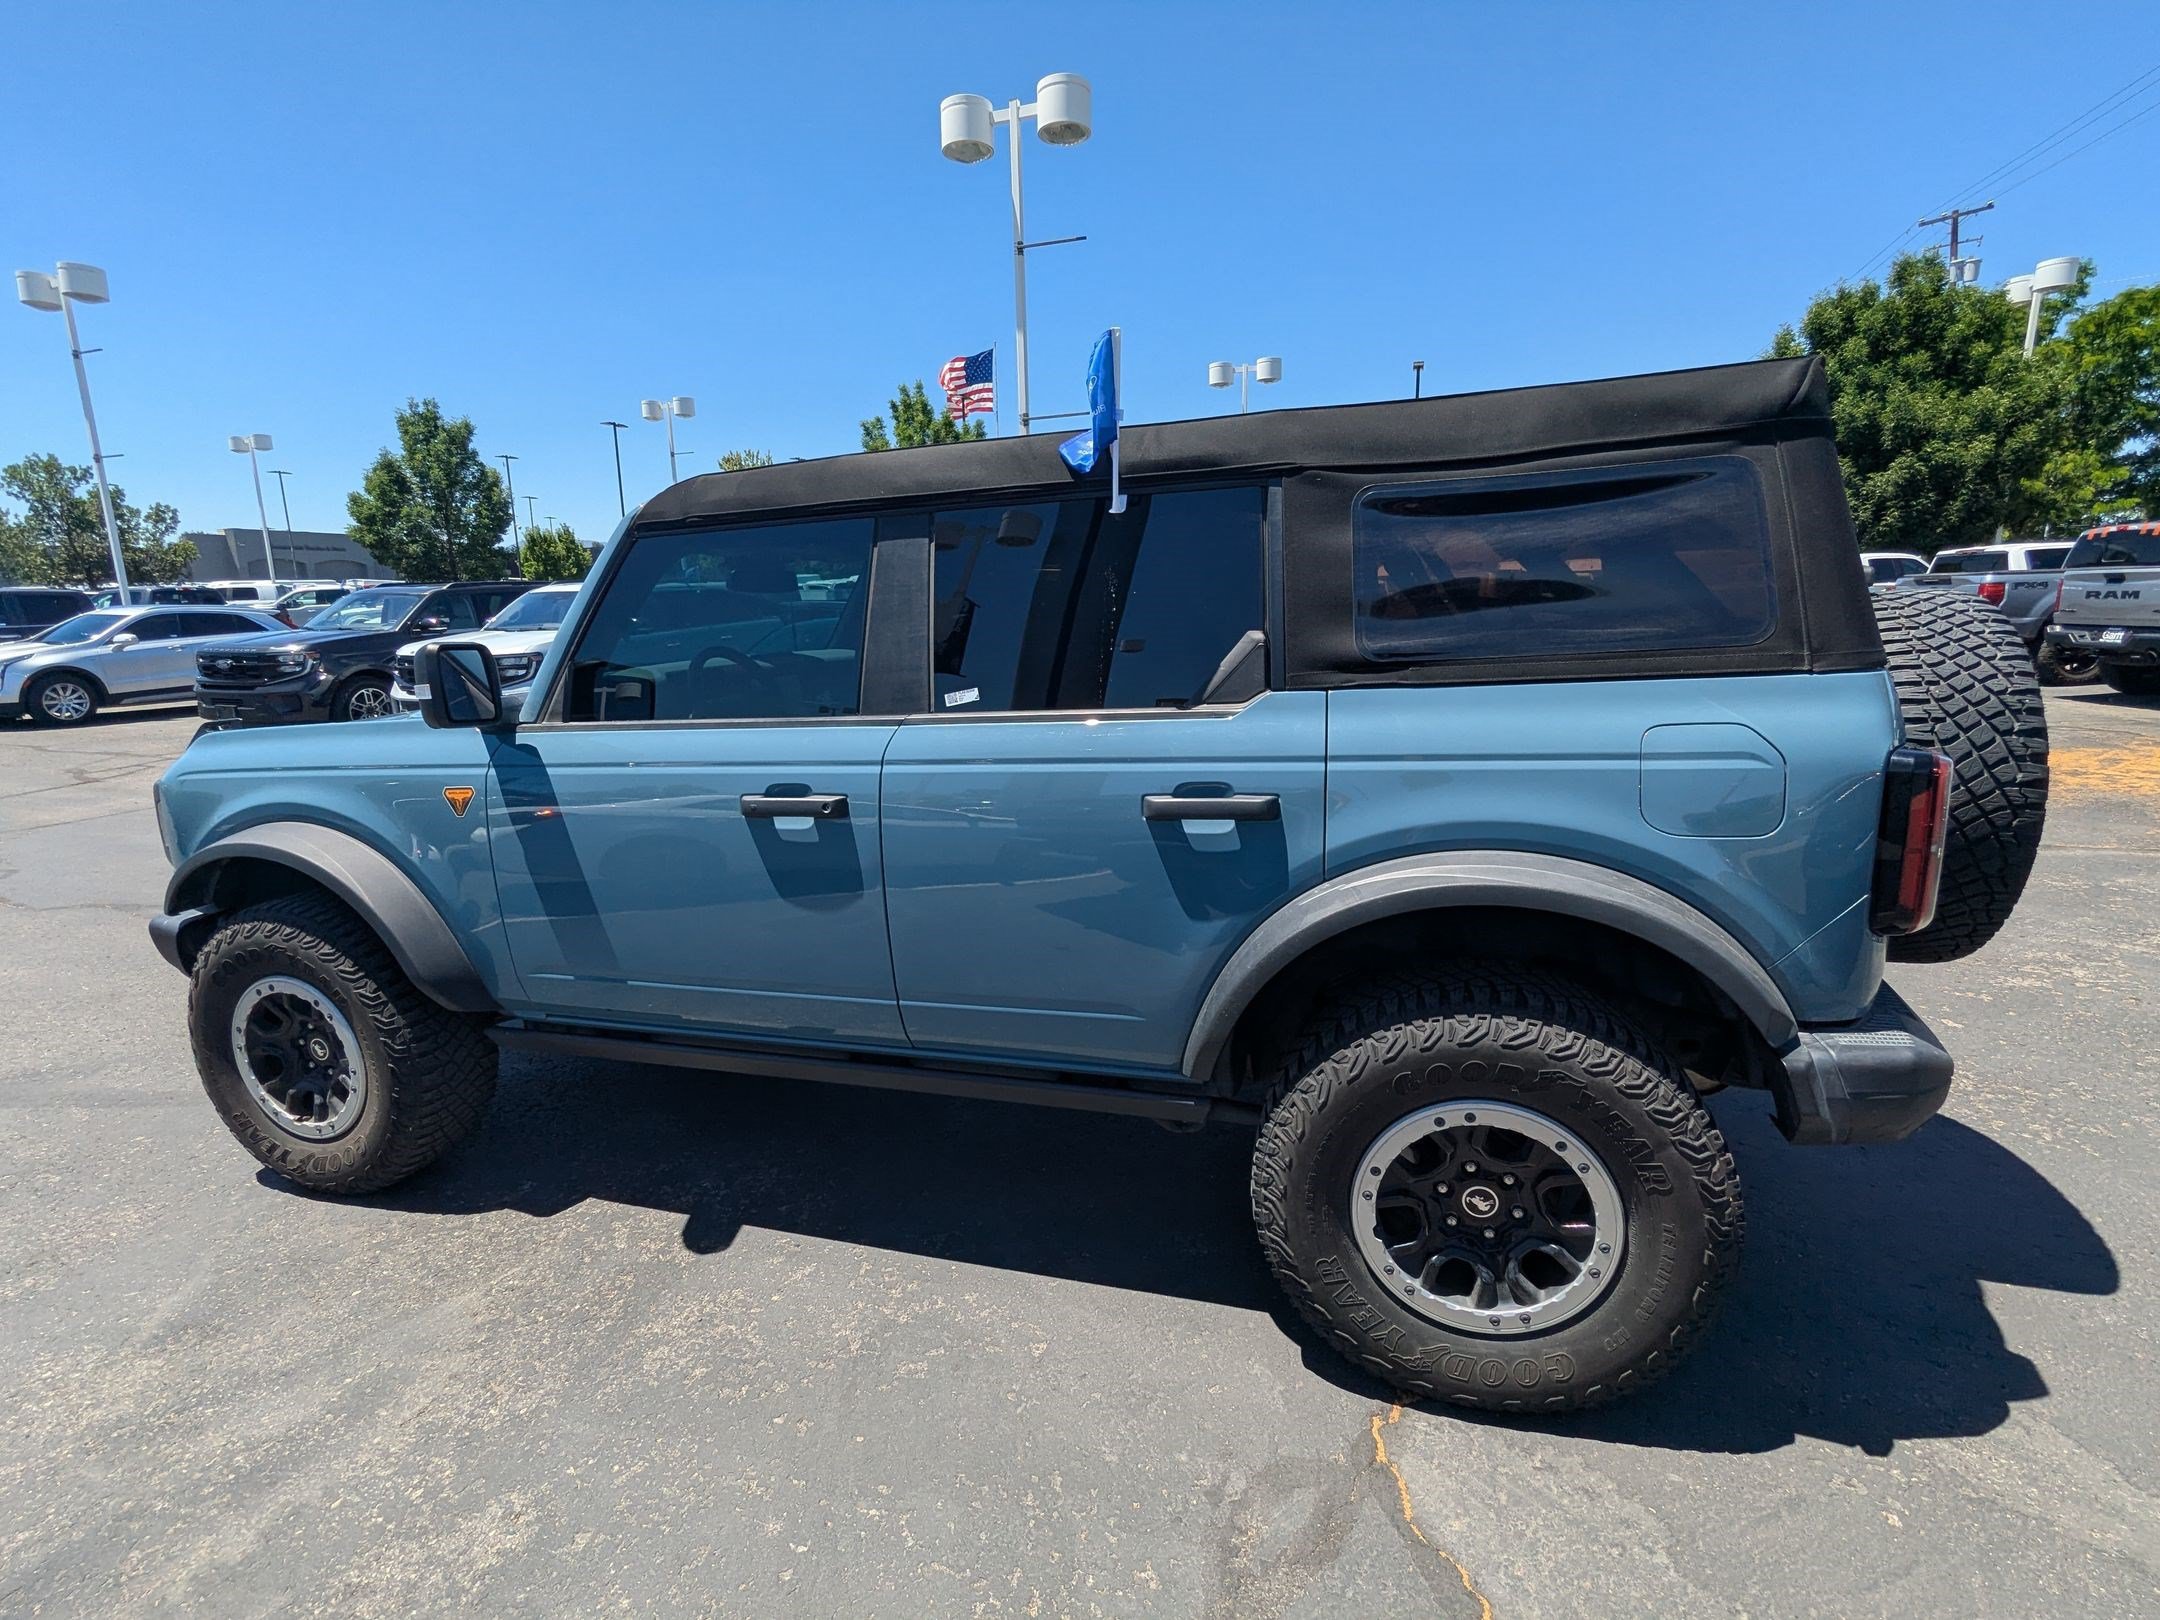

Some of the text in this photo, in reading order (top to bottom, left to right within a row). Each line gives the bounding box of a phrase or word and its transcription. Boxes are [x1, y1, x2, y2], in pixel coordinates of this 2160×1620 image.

[2084, 590, 2141, 600] RAM
[231, 1110, 368, 1177] GOODYEAR
[1313, 1254, 1577, 1387] GOODYEAR
